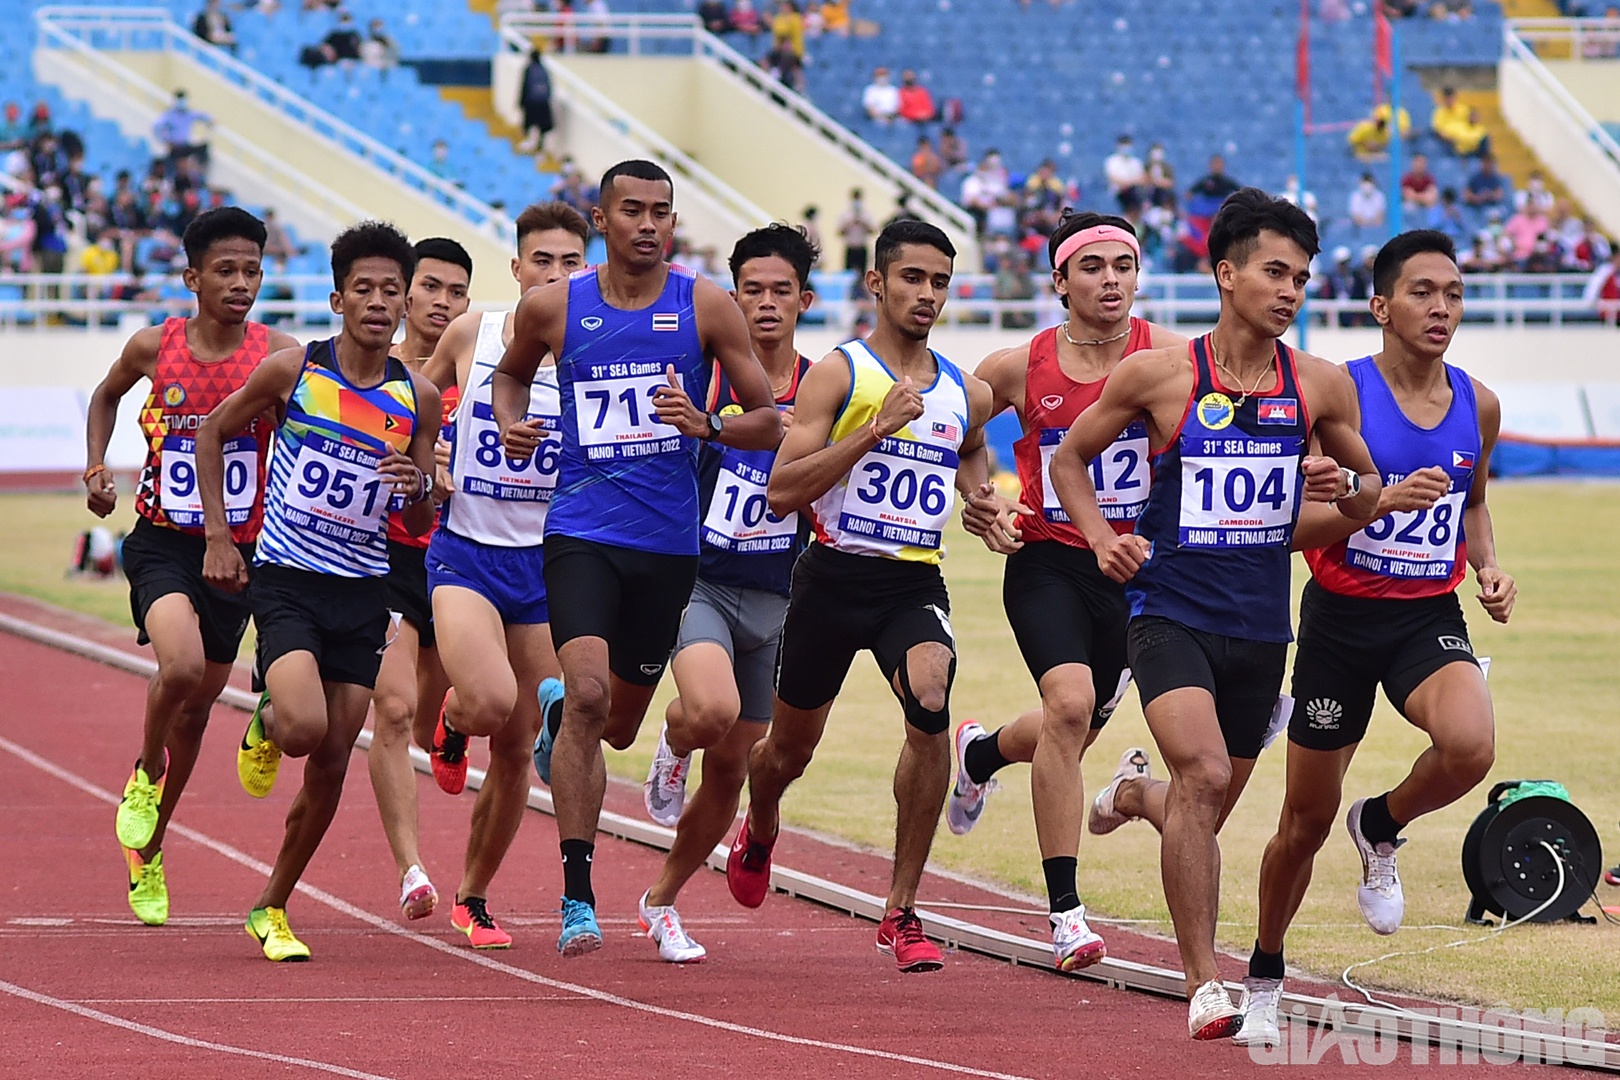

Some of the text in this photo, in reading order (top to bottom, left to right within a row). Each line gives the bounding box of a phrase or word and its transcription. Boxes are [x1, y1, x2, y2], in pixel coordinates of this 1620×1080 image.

[609, 363, 629, 377] SEA
[630, 362, 661, 375] Games
[615, 431, 653, 441] THAILAND
[338, 445, 356, 462] SEA
[356, 450, 381, 468] Game
[588, 445, 615, 460] HANOI
[621, 441, 659, 457] VIETNAM
[661, 438, 681, 453] 2022
[897, 442, 915, 457] SEA
[916, 446, 944, 463] Games
[1224, 440, 1245, 454] SEA
[1247, 440, 1282, 454] Games
[169, 460, 248, 497] 90
[750, 469, 768, 484] SEA
[1051, 448, 1141, 491] 12
[297, 460, 380, 517] 951
[470, 479, 494, 495] HANOI
[500, 486, 536, 500] VIETNAM
[499, 476, 532, 485] VIETNAM
[857, 461, 946, 516] 306
[1195, 467, 1287, 513] 104
[285, 507, 312, 526] HANOI
[315, 519, 351, 541] VIETNAM
[349, 530, 370, 543] 2022
[309, 506, 356, 525] TIMOR-LESTE
[879, 512, 918, 526] MALAYSIA
[706, 530, 732, 550] HANOI
[736, 538, 770, 552] VIETNAM
[770, 536, 791, 550] 2022
[847, 517, 876, 535] HANOI
[882, 525, 920, 544] VIETNAM
[920, 532, 937, 547] 2022
[1188, 530, 1218, 545] HANOI
[1226, 530, 1266, 545] VIETNAM
[1266, 528, 1286, 543] 2022
[1353, 552, 1383, 571] HANOI
[1389, 560, 1427, 577] VIETNAM
[1425, 562, 1448, 576] 2022
[1381, 548, 1431, 560] PHILIPPINES
